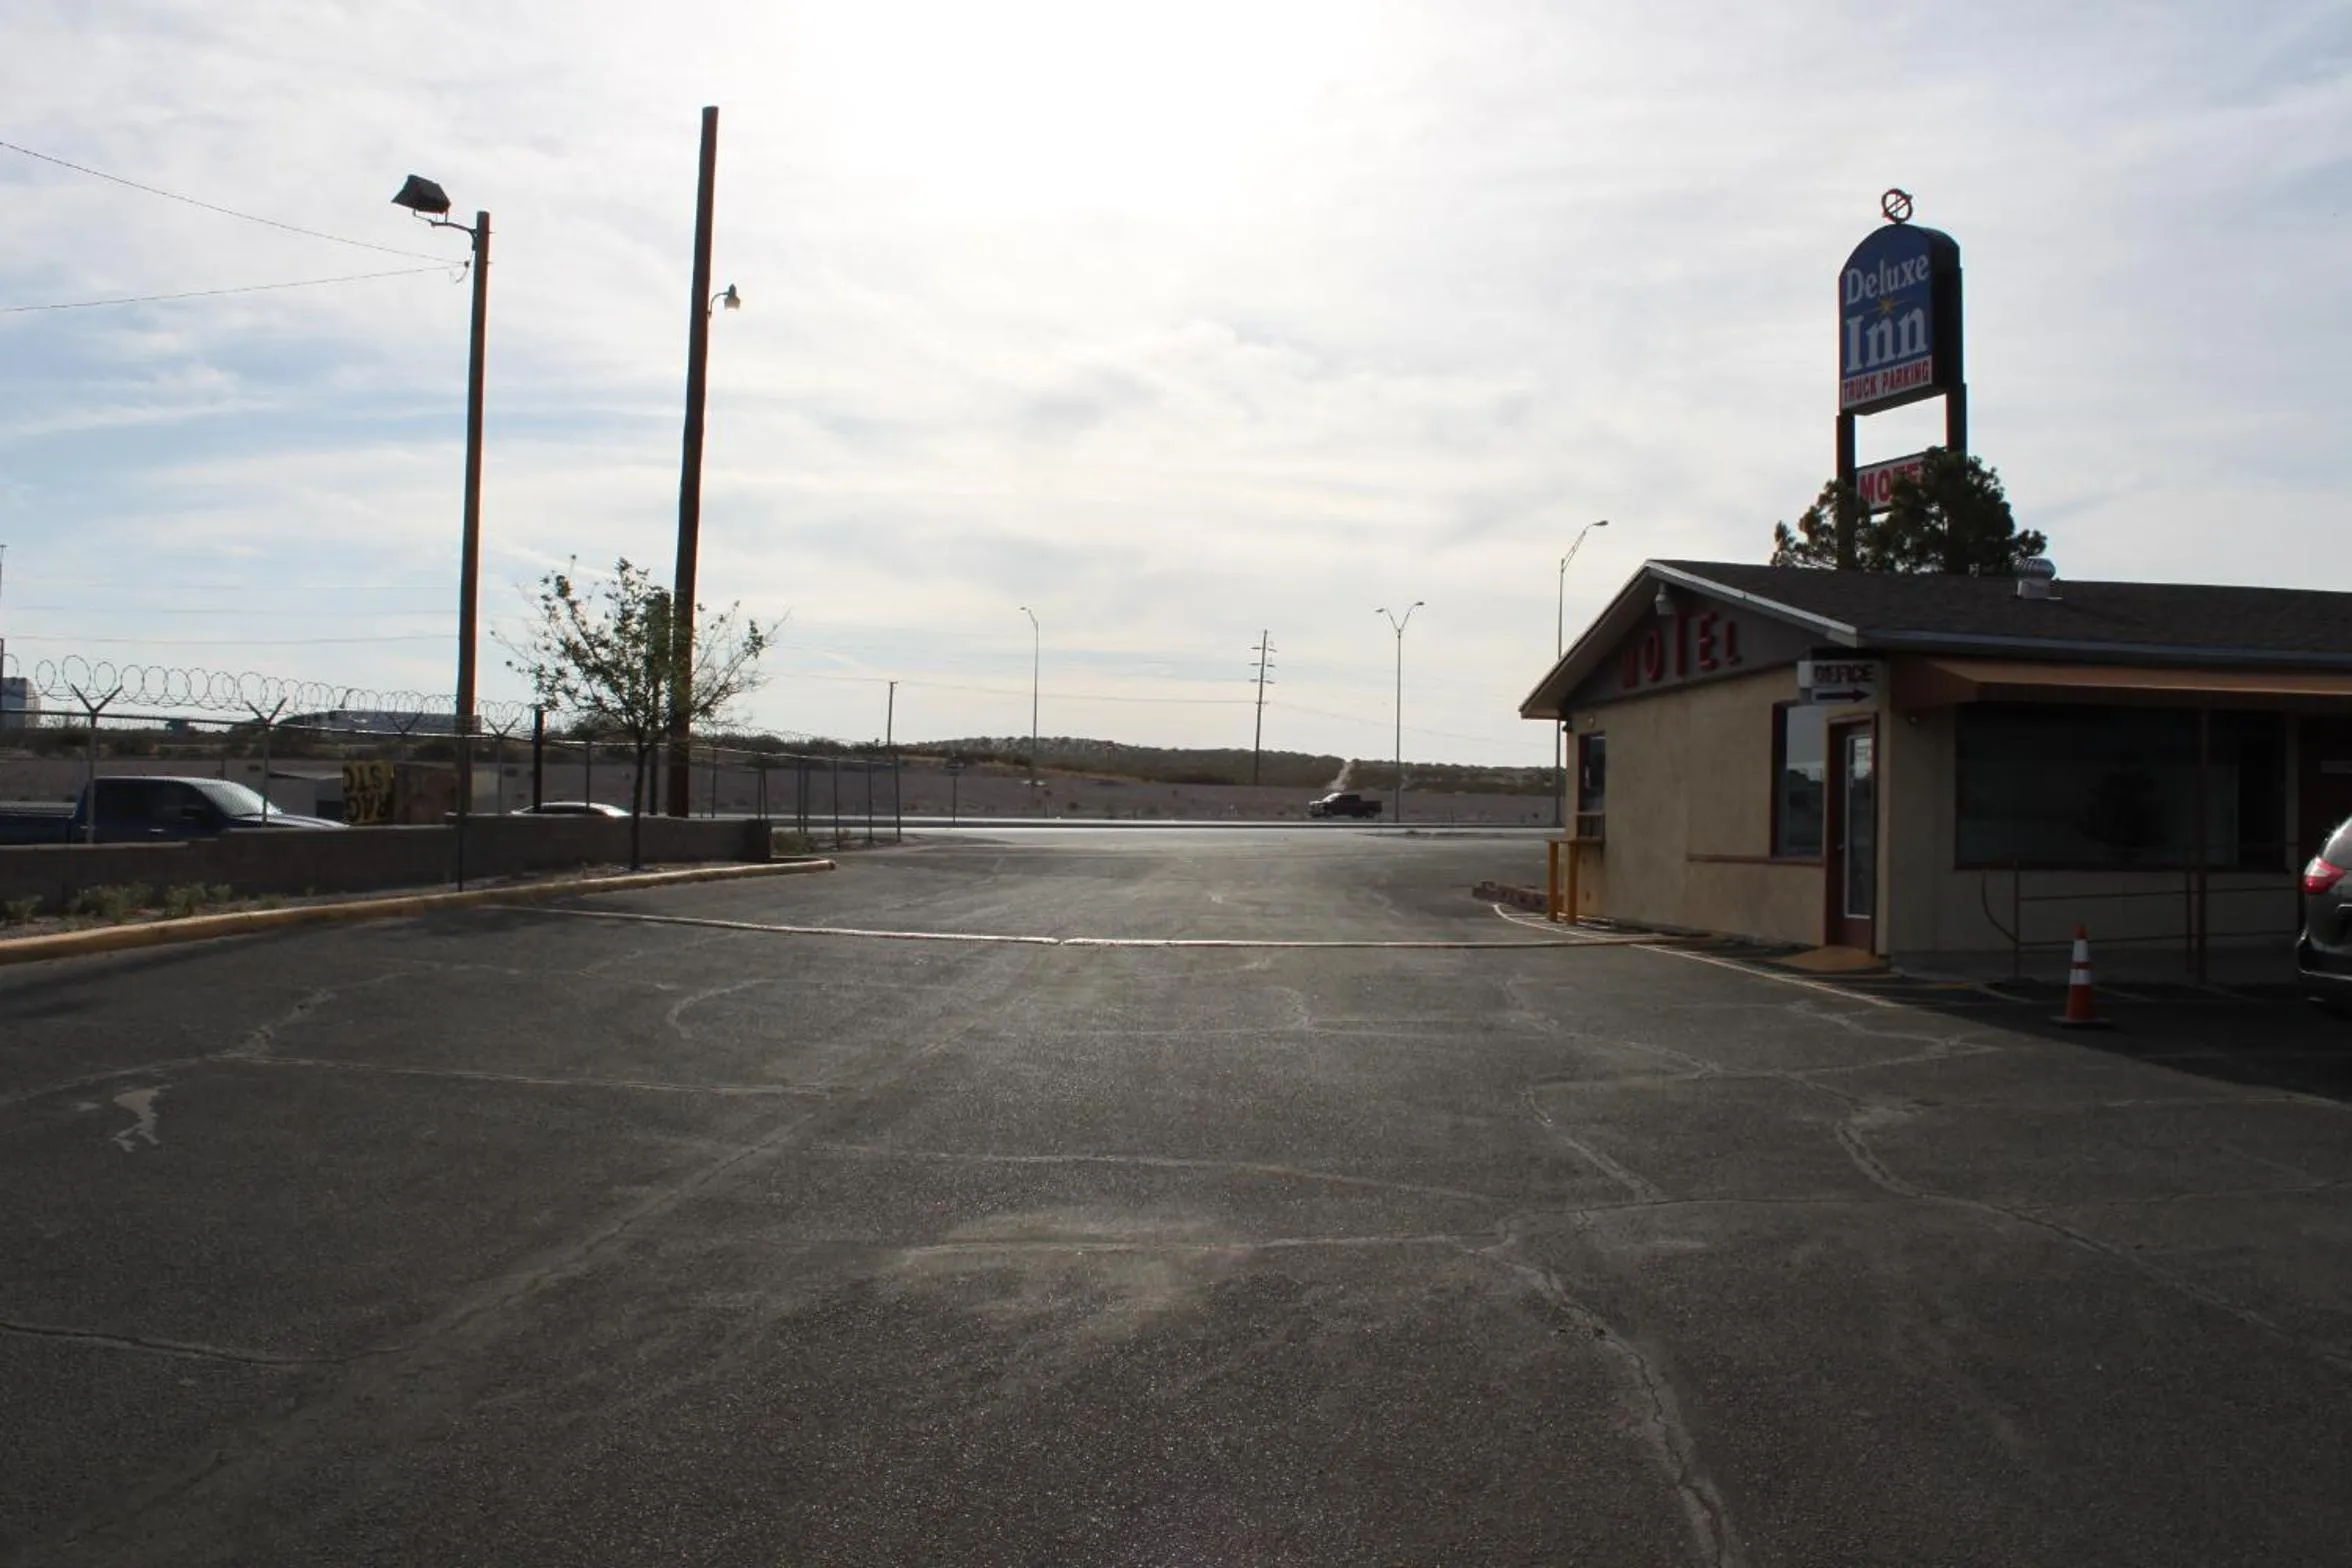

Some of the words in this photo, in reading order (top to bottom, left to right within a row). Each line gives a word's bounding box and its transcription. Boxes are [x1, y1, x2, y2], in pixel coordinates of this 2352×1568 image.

[1845, 253, 1931, 306] Deluxe
[1846, 306, 1928, 373] Inn
[1843, 373, 1877, 400] TRUCK
[1881, 361, 1929, 395] PARKING
[1814, 664, 1873, 682] OFFICE
